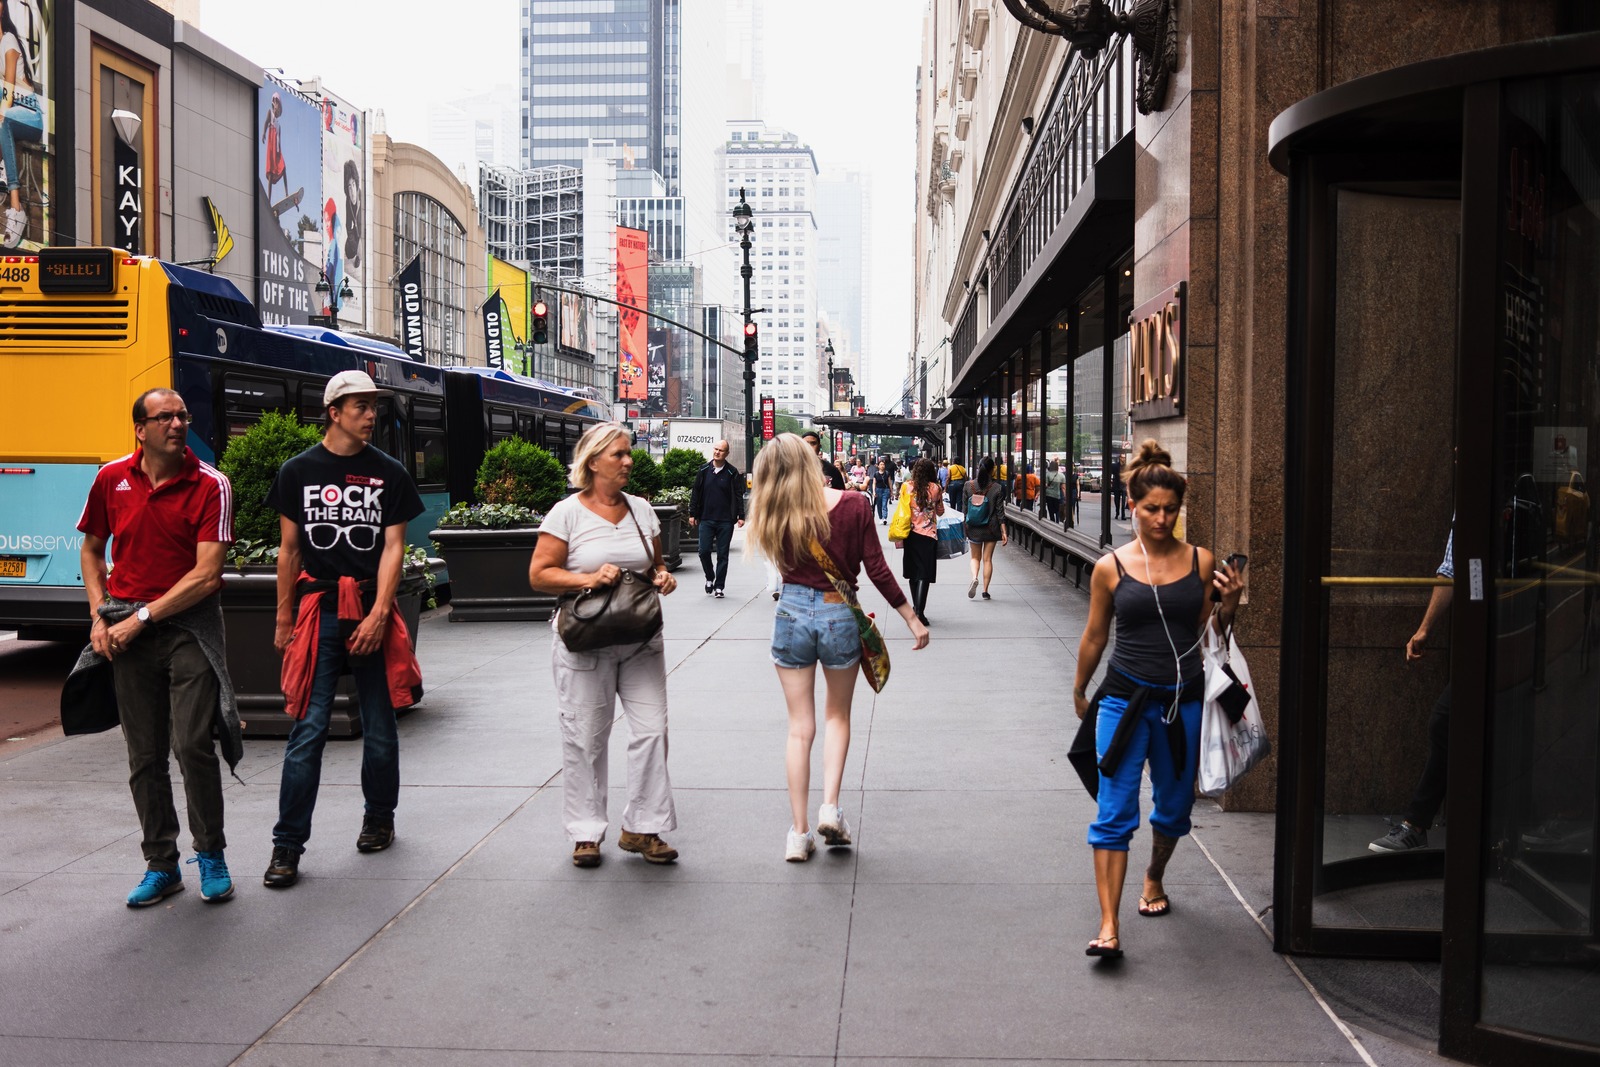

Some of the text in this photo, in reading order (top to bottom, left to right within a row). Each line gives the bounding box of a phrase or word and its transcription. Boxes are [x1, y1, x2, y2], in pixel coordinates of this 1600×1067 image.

[119, 165, 137, 236] KAY
[0, 267, 30, 282] 488
[262, 249, 304, 282] THIS IS
[263, 280, 309, 312] OFF THE
[404, 282, 423, 357] OLD NAVY
[486, 312, 500, 338] OLD
[375, 361, 388, 380] NY
[677, 435, 714, 443] 07Z45C0121
[303, 484, 384, 510] FOCK
[304, 506, 382, 524] THE RAIN
